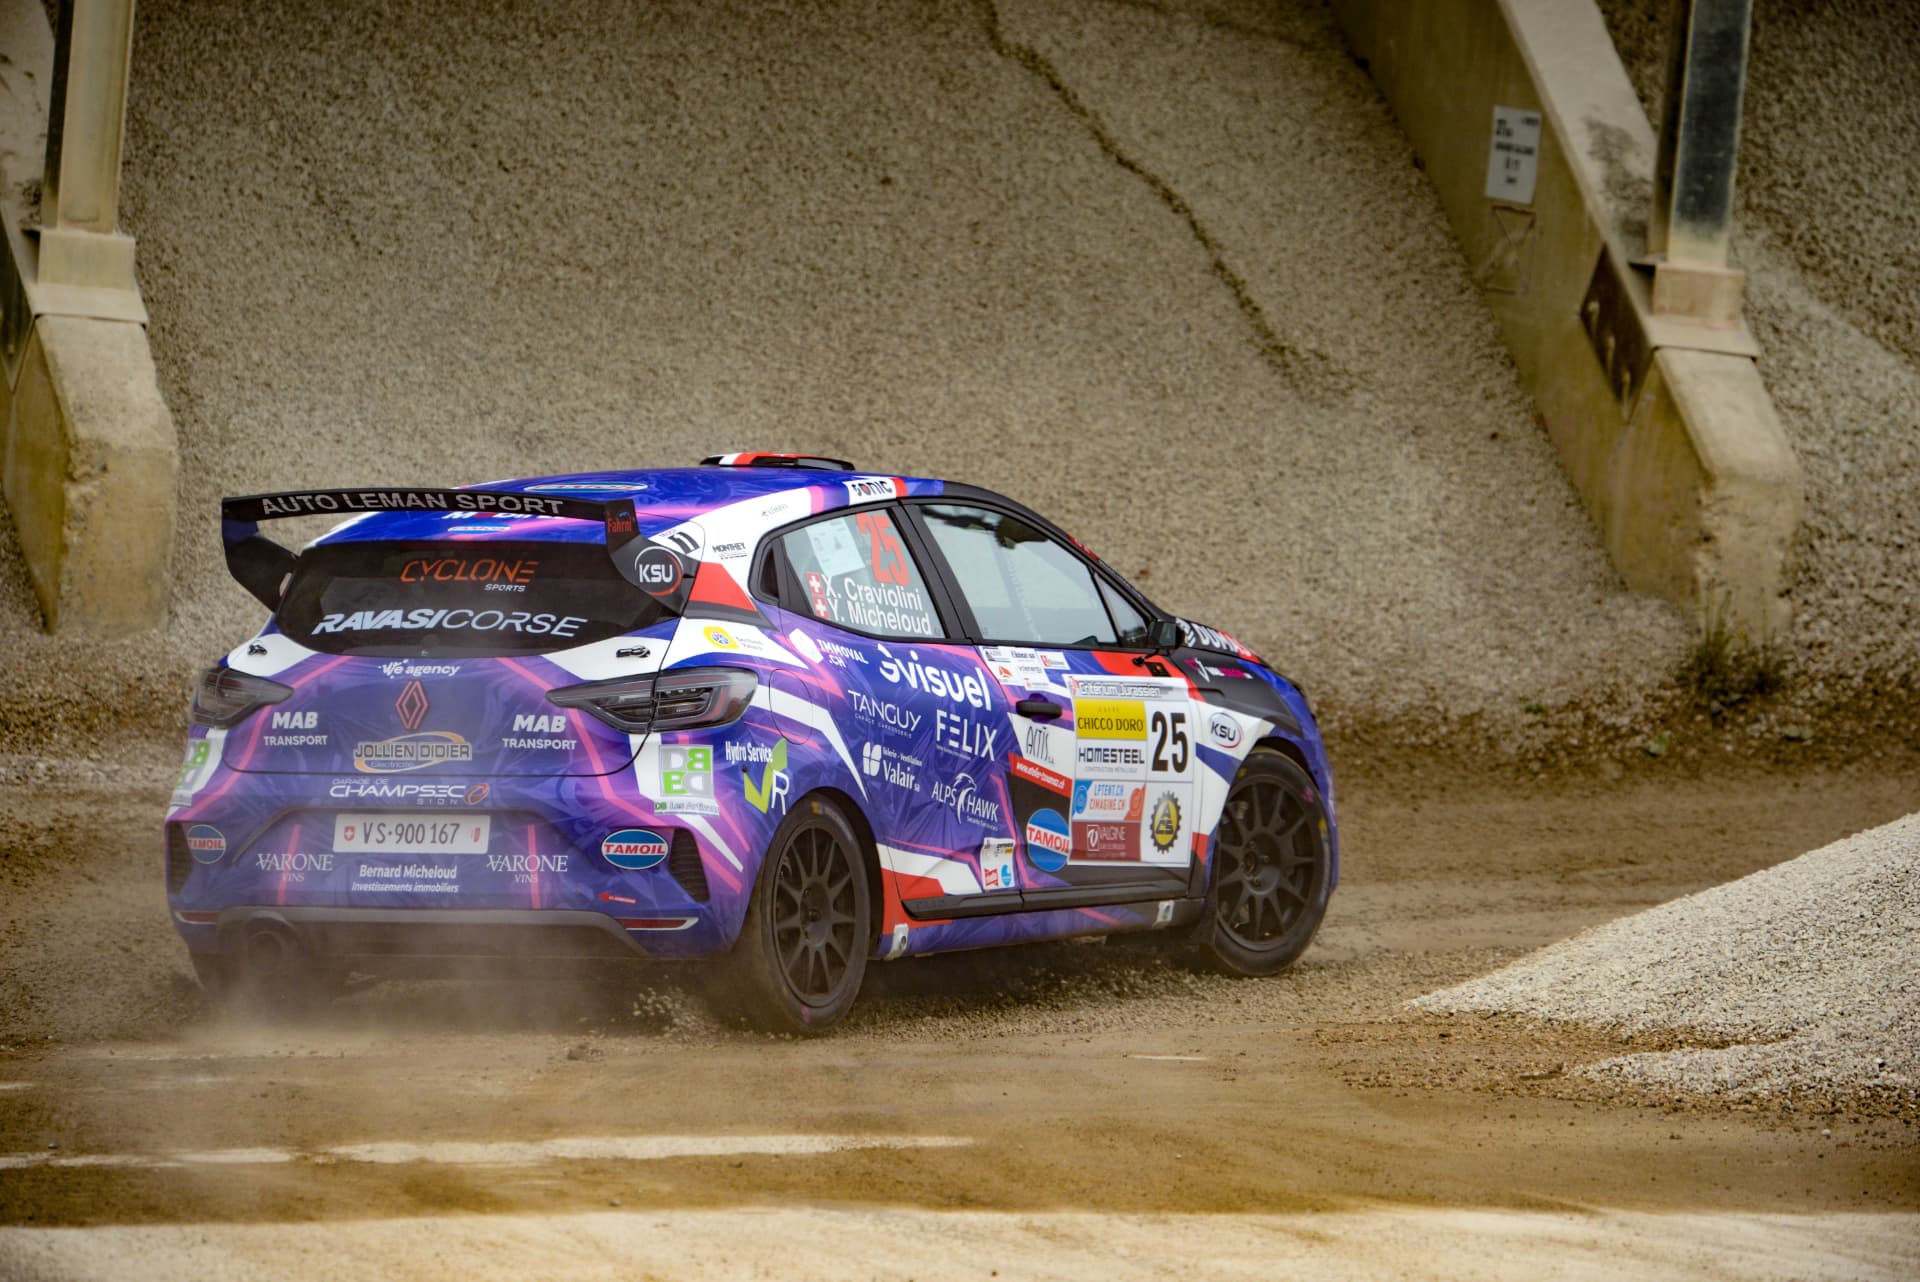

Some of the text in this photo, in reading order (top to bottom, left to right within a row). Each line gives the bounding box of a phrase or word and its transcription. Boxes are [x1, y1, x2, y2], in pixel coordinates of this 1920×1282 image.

[262, 494, 339, 515] AUTO
[348, 492, 448, 510] LEMAN
[456, 493, 564, 516] SPORT
[855, 511, 911, 587] 25
[400, 559, 539, 583] CYCLONE
[638, 563, 674, 584] KSU
[484, 583, 526, 593] SPORTS
[828, 598, 933, 636] Y. Micheloud
[405, 665, 461, 677] agency
[272, 711, 318, 729] MAB
[848, 689, 922, 732] TANGUY
[512, 713, 567, 733] MAB
[1077, 717, 1114, 731] CHICCO
[1210, 721, 1237, 742] KSU
[263, 735, 328, 746] TRANSPORT
[502, 737, 577, 750] TRANSPORT
[936, 708, 999, 762] FELIX
[1151, 710, 1188, 774] 25
[354, 743, 471, 759] JOLLIEN DIDIER
[725, 741, 773, 764] Hydro Service
[1078, 747, 1145, 764] HOMESTEEL
[883, 759, 916, 789] Valair
[329, 784, 466, 798] CHAMPSEC
[931, 781, 999, 822] ALPS HAWK
[189, 839, 225, 849] TAMOIL
[603, 843, 665, 855] TAMOIL
[256, 853, 334, 872] VARONE
[359, 864, 458, 879] Bernard Micheloud
[487, 855, 568, 872] VARONE
